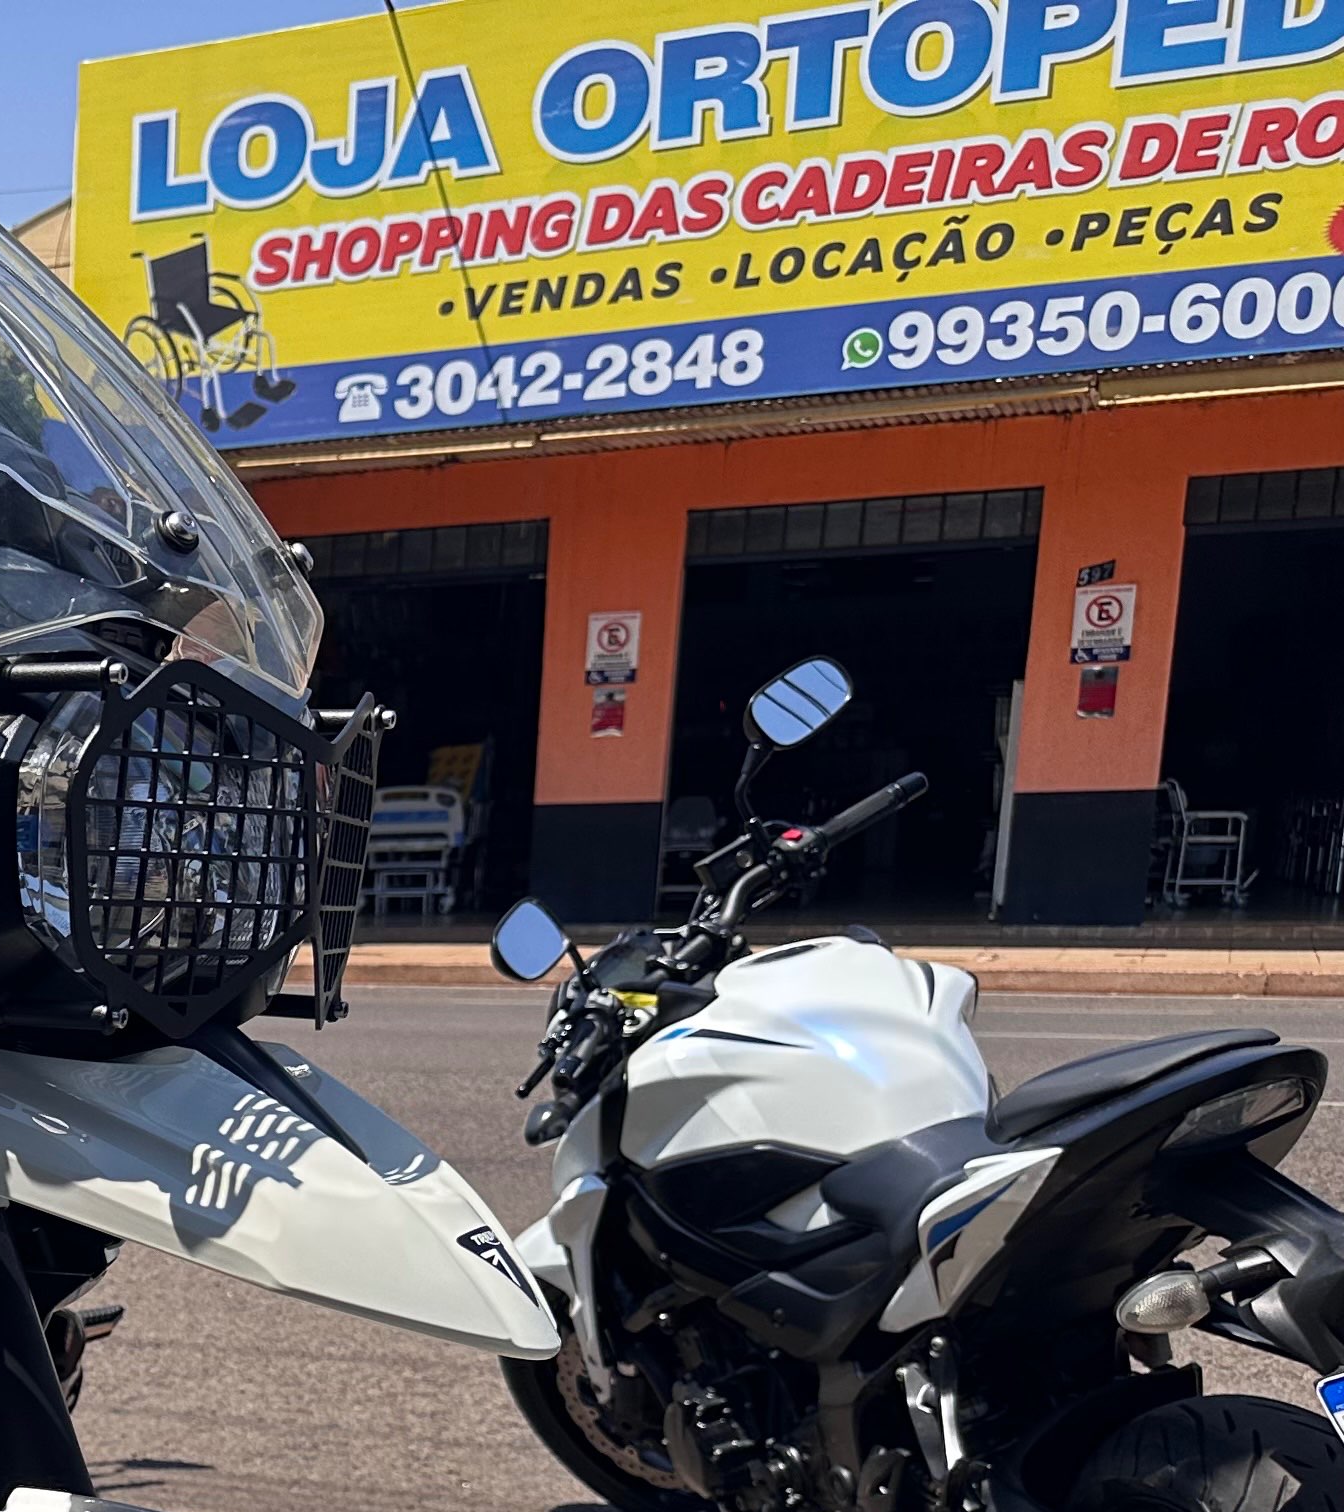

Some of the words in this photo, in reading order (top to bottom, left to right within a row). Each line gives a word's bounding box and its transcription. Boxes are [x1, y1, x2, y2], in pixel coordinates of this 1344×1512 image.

[132, 66, 500, 222] LOJA
[250, 196, 578, 290] SHOPPING
[584, 180, 728, 249] DAS
[740, 129, 1110, 228] CADEIRAS
[1115, 111, 1235, 184] DE
[1238, 96, 1344, 168] RO
[393, 328, 765, 420] 3042-2848
[886, 271, 1344, 370] 99350-600
